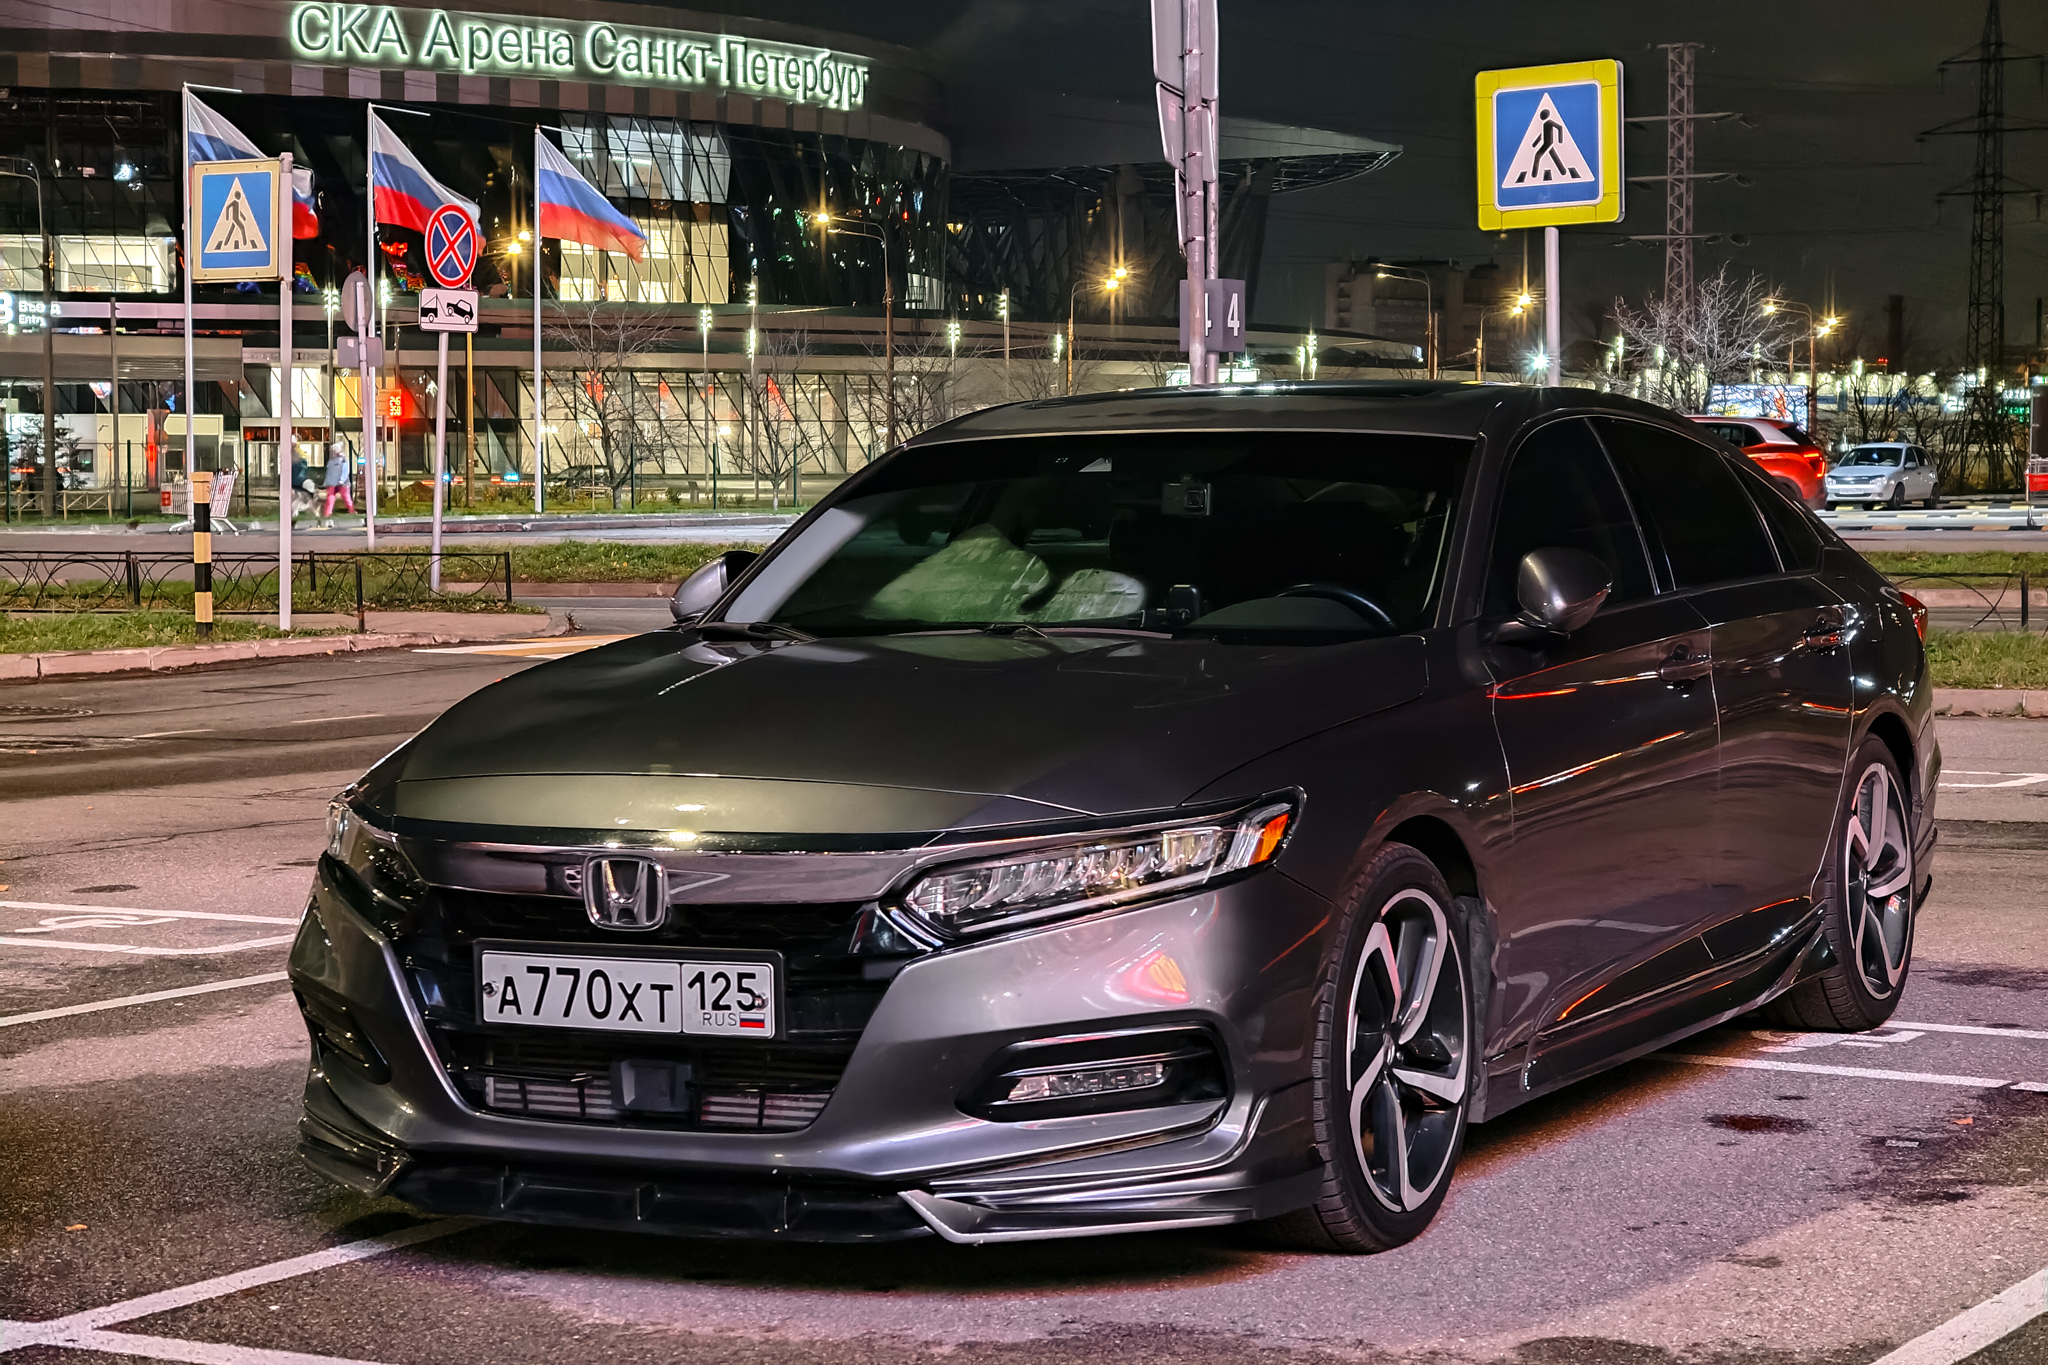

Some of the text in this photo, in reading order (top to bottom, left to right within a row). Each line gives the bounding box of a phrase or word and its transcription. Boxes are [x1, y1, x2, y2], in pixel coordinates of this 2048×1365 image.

[292, 3, 868, 109] СКА Арена Санкт-Петербург
[19, 301, 61, 315] Въед
[1227, 292, 1240, 337] 4
[498, 965, 757, 1023] А770ХТ 125
[702, 1012, 738, 1027] RUS
